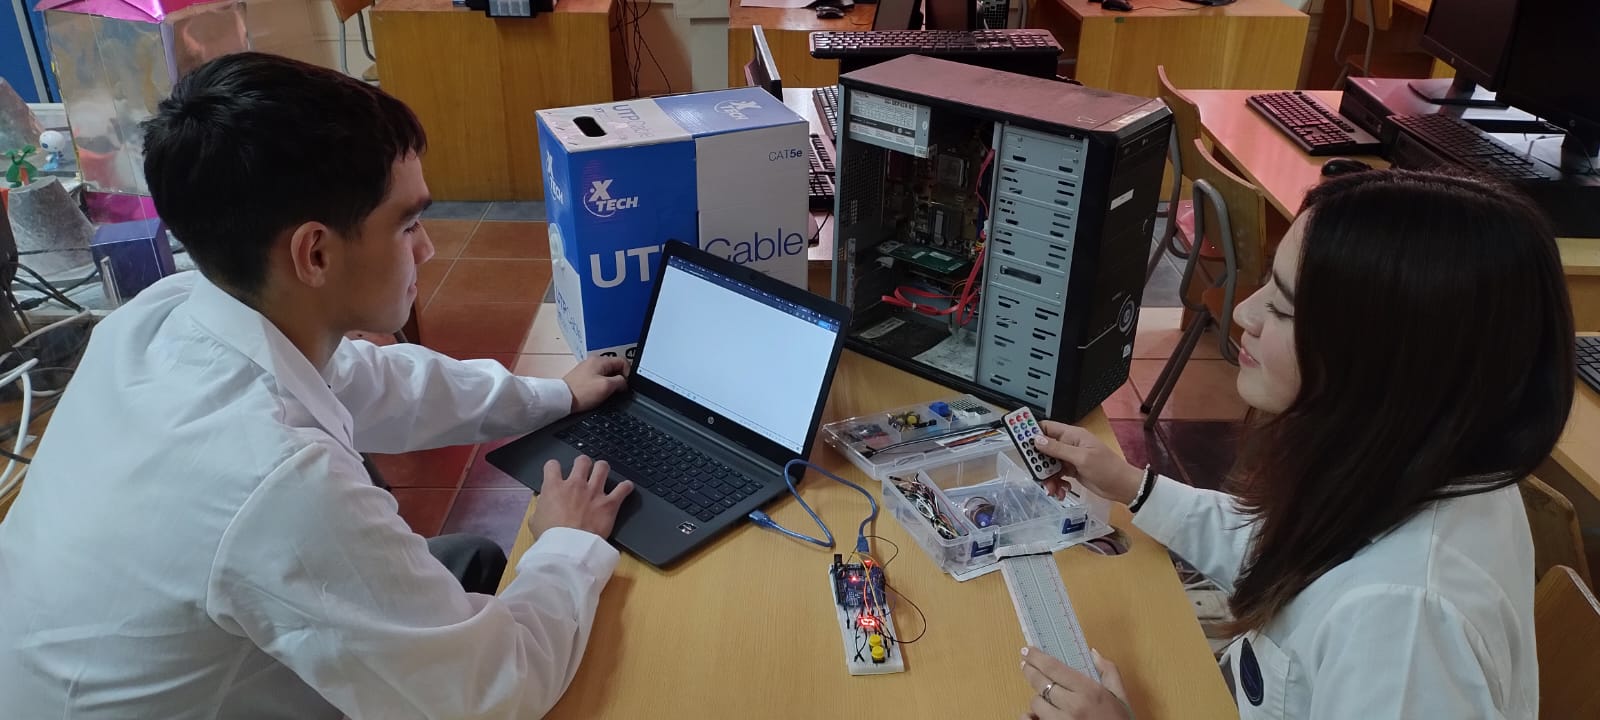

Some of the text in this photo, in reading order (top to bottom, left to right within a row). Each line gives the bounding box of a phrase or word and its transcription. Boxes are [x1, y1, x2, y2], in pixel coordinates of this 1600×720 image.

[612, 103, 641, 121] UTP
[768, 149, 803, 161] CAT5e
[549, 176, 564, 205] TECH
[588, 179, 613, 202] X
[595, 196, 639, 212] TECH
[589, 227, 803, 288] UT Cable
